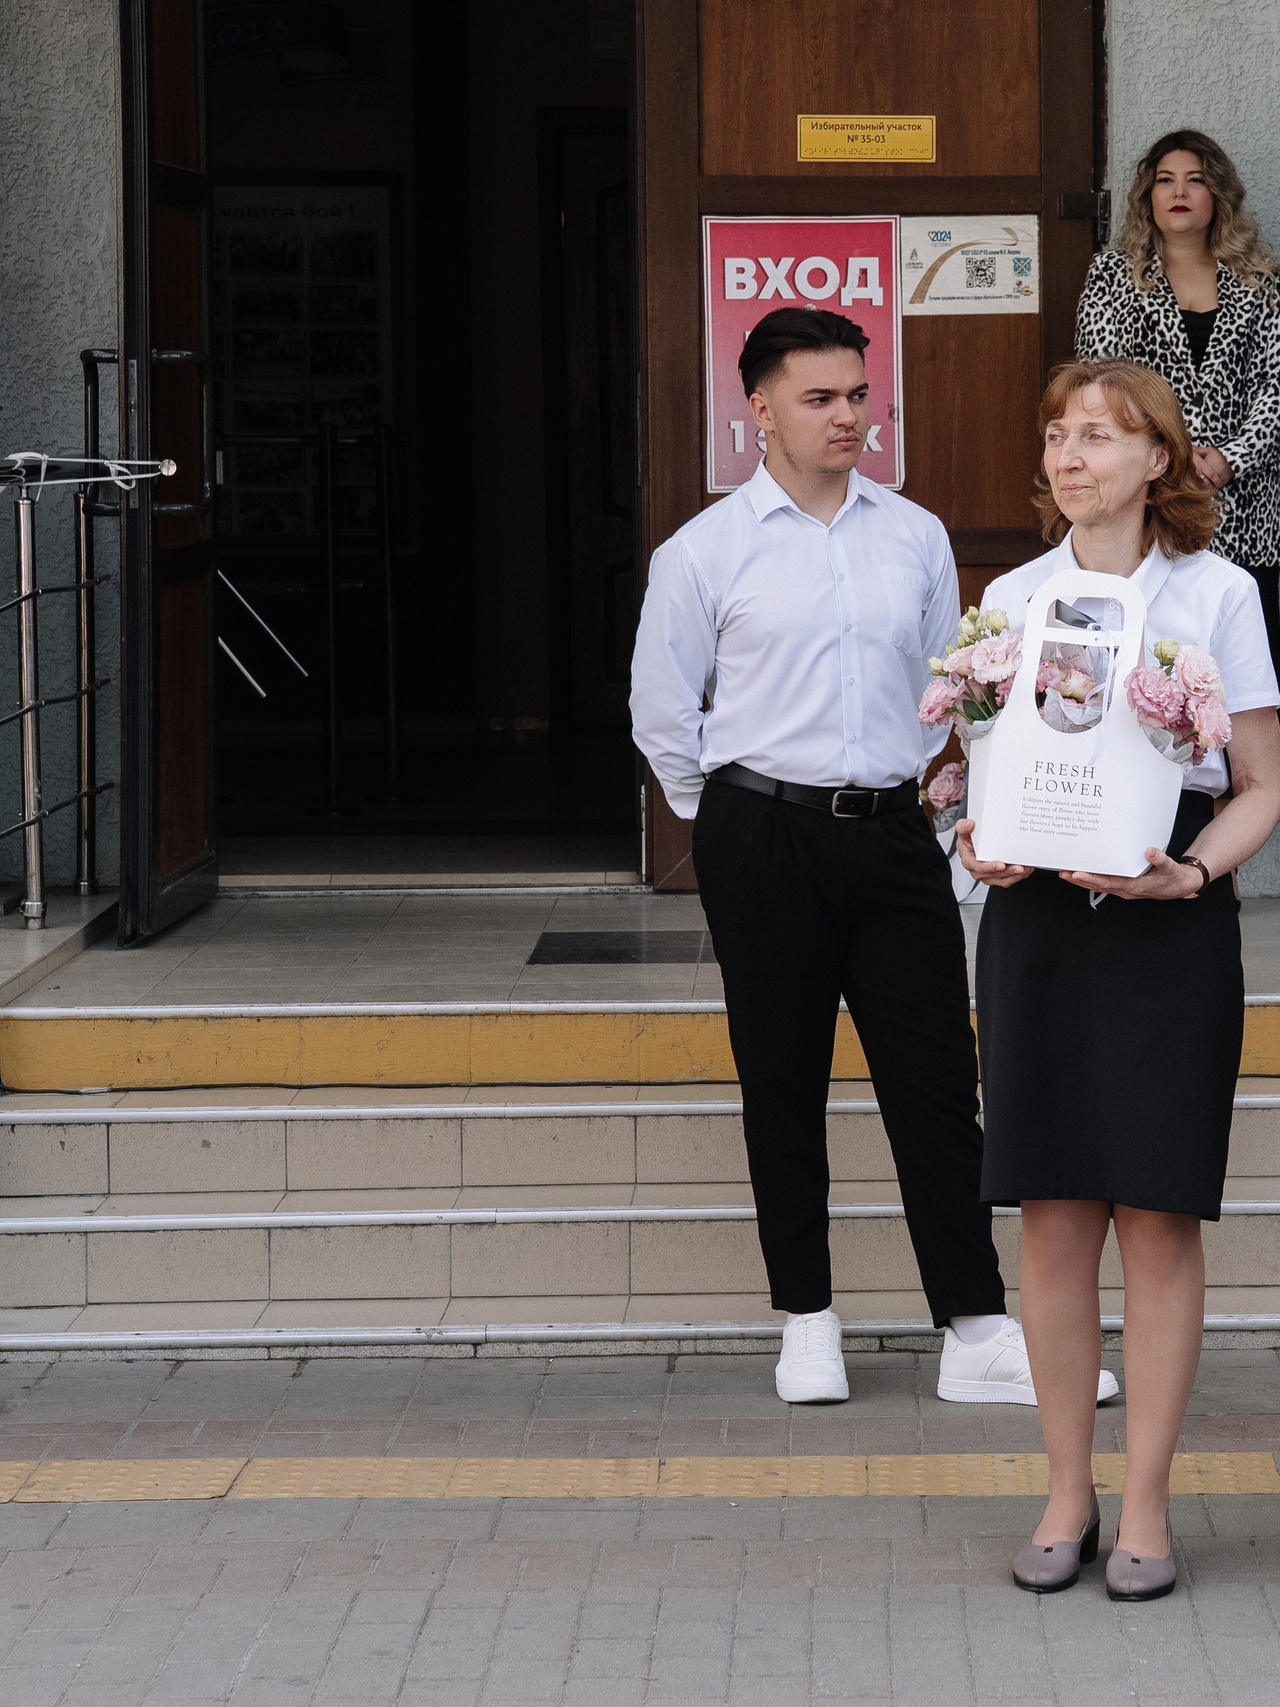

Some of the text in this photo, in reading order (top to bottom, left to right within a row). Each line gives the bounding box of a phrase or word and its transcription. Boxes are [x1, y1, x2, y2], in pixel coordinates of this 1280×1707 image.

[811, 122, 922, 132] Избирательный участок
[861, 135, 886, 143] 35-03
[931, 230, 951, 241] 2024
[724, 256, 883, 306] ВХОД
[1034, 761, 1095, 779] FRESH
[1023, 777, 1103, 797] FLOWER
